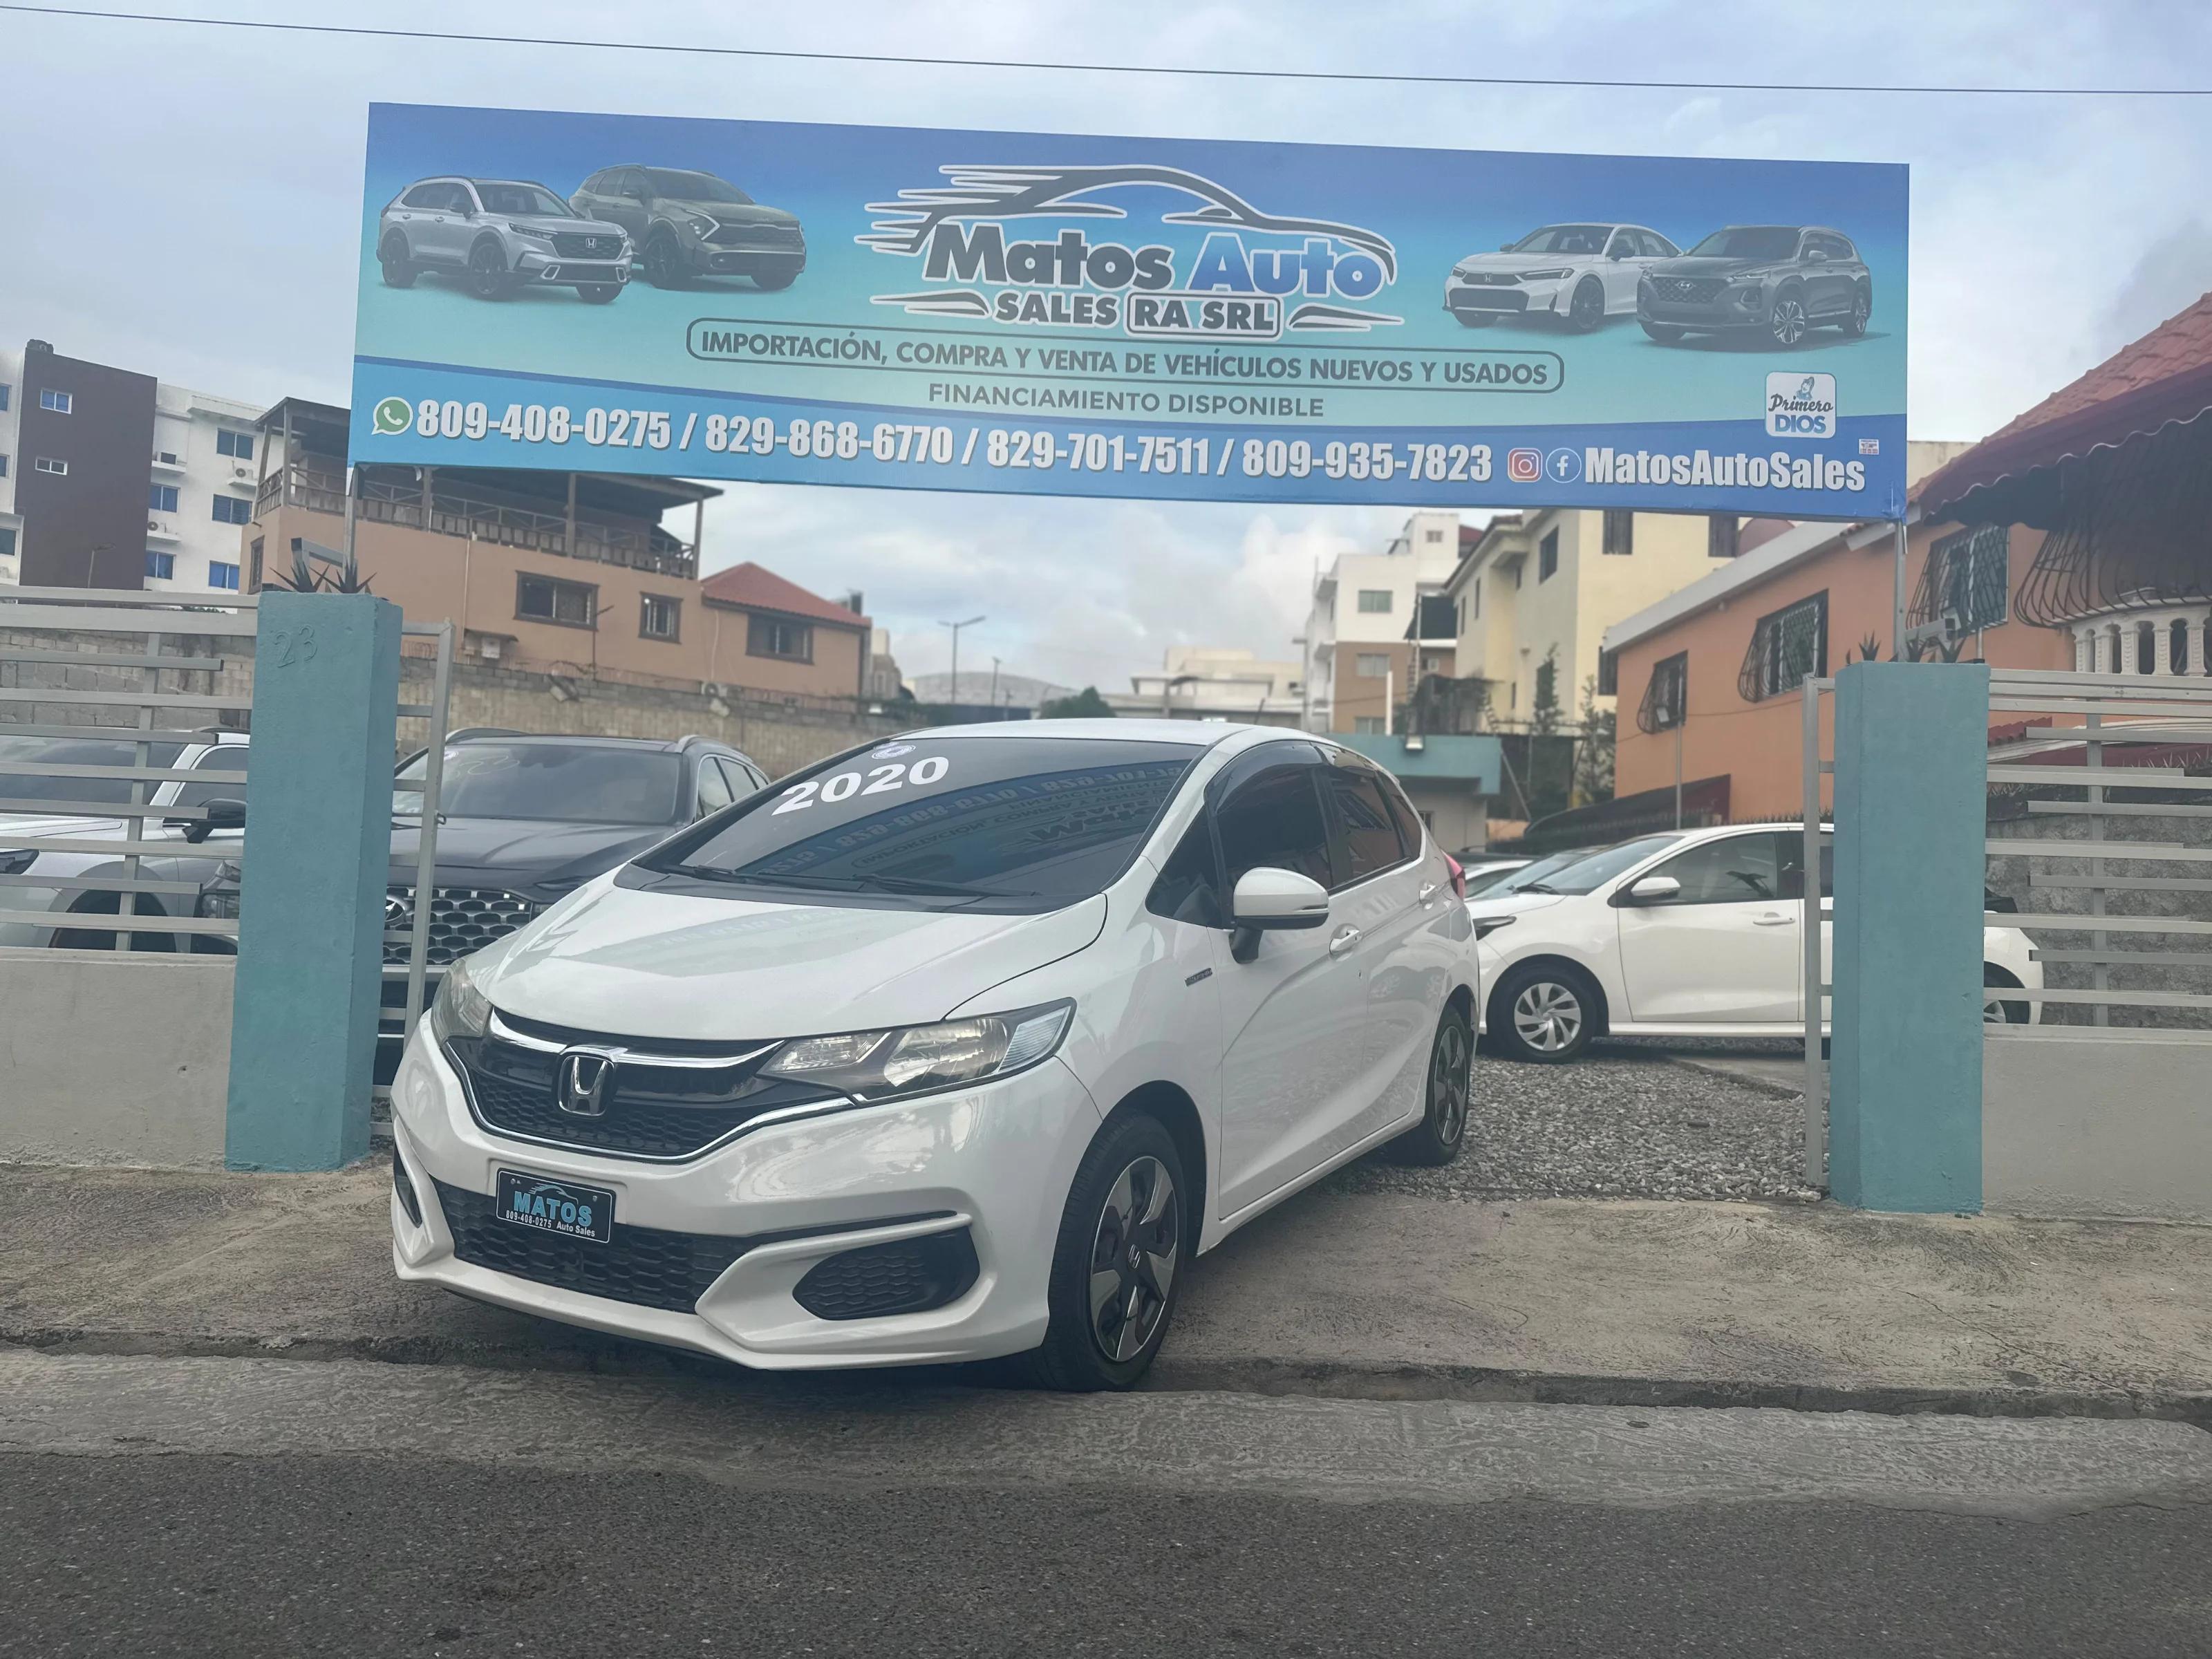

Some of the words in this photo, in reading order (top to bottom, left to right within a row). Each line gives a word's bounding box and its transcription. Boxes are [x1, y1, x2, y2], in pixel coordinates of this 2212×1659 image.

[925, 223, 1173, 290] Matos
[1188, 234, 1382, 298] Auto
[995, 292, 1118, 325] SALES
[1134, 298, 1190, 328] RA
[1201, 301, 1274, 331] SRL
[702, 330, 887, 365] IMPORTACIÓN,
[896, 341, 1009, 368] COMPRA
[1015, 348, 1031, 368] Y
[1038, 348, 1118, 373] VENTA
[1125, 353, 1156, 374] DE
[1164, 348, 1302, 379] VEHÍCULOS
[1310, 358, 1413, 382] NUEVOS
[1420, 362, 1437, 382] Y
[1444, 362, 1548, 385] USADOS
[929, 383, 1161, 412] FINANCIAMIENTO
[1168, 393, 1324, 417] DISPONIBLE
[1768, 393, 1834, 413] Primero
[416, 399, 671, 449] 809-408-0275
[705, 414, 954, 464] 829-868-6770
[987, 429, 1209, 475] 829-701-7511
[1242, 439, 1492, 481] 809-935-7823
[1774, 414, 1826, 434] DIOS
[1585, 447, 1866, 492] MatosAutoSales
[771, 756, 950, 816] 2020
[505, 1210, 552, 1229] 809-408-0275
[556, 1221, 574, 1232] Auto
[575, 1226, 596, 1237] Sales
[514, 1190, 592, 1228] MATOS
